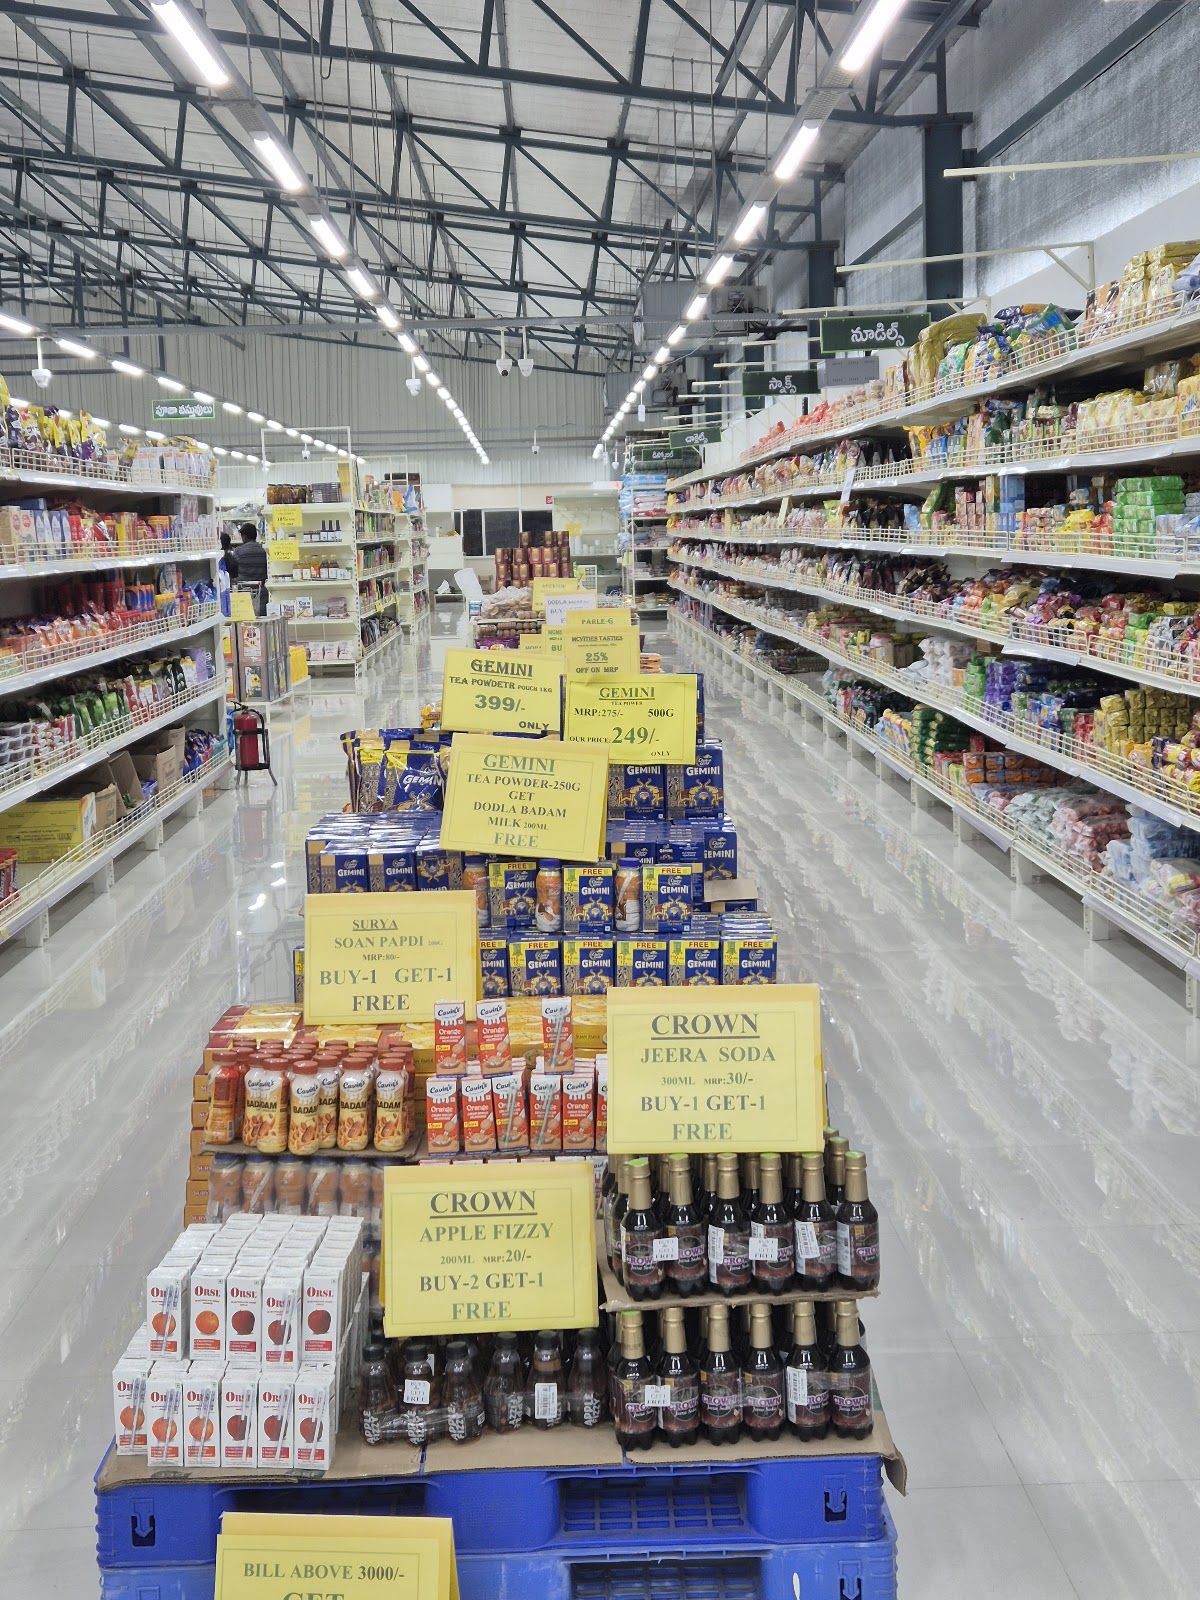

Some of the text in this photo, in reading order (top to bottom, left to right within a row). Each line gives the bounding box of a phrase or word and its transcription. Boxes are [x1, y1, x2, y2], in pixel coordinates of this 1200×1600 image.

[585, 652, 609, 662] 25%
[470, 658, 533, 677] GEMINI
[449, 676, 468, 685] TEA
[471, 678, 516, 690] POWDETR
[517, 684, 538, 692] POUCH
[599, 687, 655, 698] GEMINI
[474, 694, 526, 712] 399/-
[647, 708, 674, 718] 500G
[518, 721, 550, 730] ONLY
[569, 735, 587, 743] OUR
[611, 727, 660, 744] 249/-
[483, 753, 555, 773] GEMINI
[627, 766, 661, 776] GEMINI
[686, 766, 720, 776] GEMINI
[467, 773, 581, 792] TEA POWDER-250G
[508, 790, 535, 801] GET
[473, 801, 567, 818] DODLA BADAM
[488, 816, 549, 831] MILK 200ML
[494, 832, 539, 848] FREE
[337, 868, 365, 877] GEMINI
[385, 866, 413, 876] GEMINI
[505, 880, 535, 890] GEMINI
[581, 886, 610, 895] GEMINI
[660, 885, 689, 894] GEMINI
[352, 918, 398, 930] SURYA
[334, 937, 375, 949] SOAN
[379, 935, 423, 947] PAPDI
[528, 959, 557, 969] GEMINI
[581, 959, 611, 968] GEMINI
[635, 960, 664, 969] GEMINI
[687, 959, 717, 969] GEMINI
[741, 959, 771, 969] GEMINI
[319, 967, 452, 986] BUY-1 GET-1
[352, 994, 410, 1012] FREE
[437, 1006, 461, 1017] Cavin's
[480, 1005, 503, 1016] Cavin's
[651, 1013, 758, 1035] CROWN
[438, 1028, 461, 1036] Orange
[640, 1046, 776, 1064] JEERA SODA
[566, 1081, 589, 1091] Cavin's
[661, 1076, 695, 1086] 300ML
[429, 1084, 453, 1094] Cavin's
[465, 1082, 488, 1093] Cavin's
[641, 1094, 765, 1112] BUY-1 GET-1
[672, 1123, 733, 1141] FREE
[430, 1190, 536, 1214] CROWN
[419, 1222, 554, 1242] APPLE FIZZY
[678, 1244, 705, 1257] ROWN
[440, 1255, 475, 1265] 200ML
[419, 1272, 544, 1292] BUY-2 GET-1
[194, 1286, 221, 1297] ORSL
[230, 1287, 257, 1299] ORSL
[306, 1287, 334, 1298] ORSL
[452, 1301, 512, 1320] FREE
[243, 1563, 404, 1581] BILL ABOVE 3000/-
